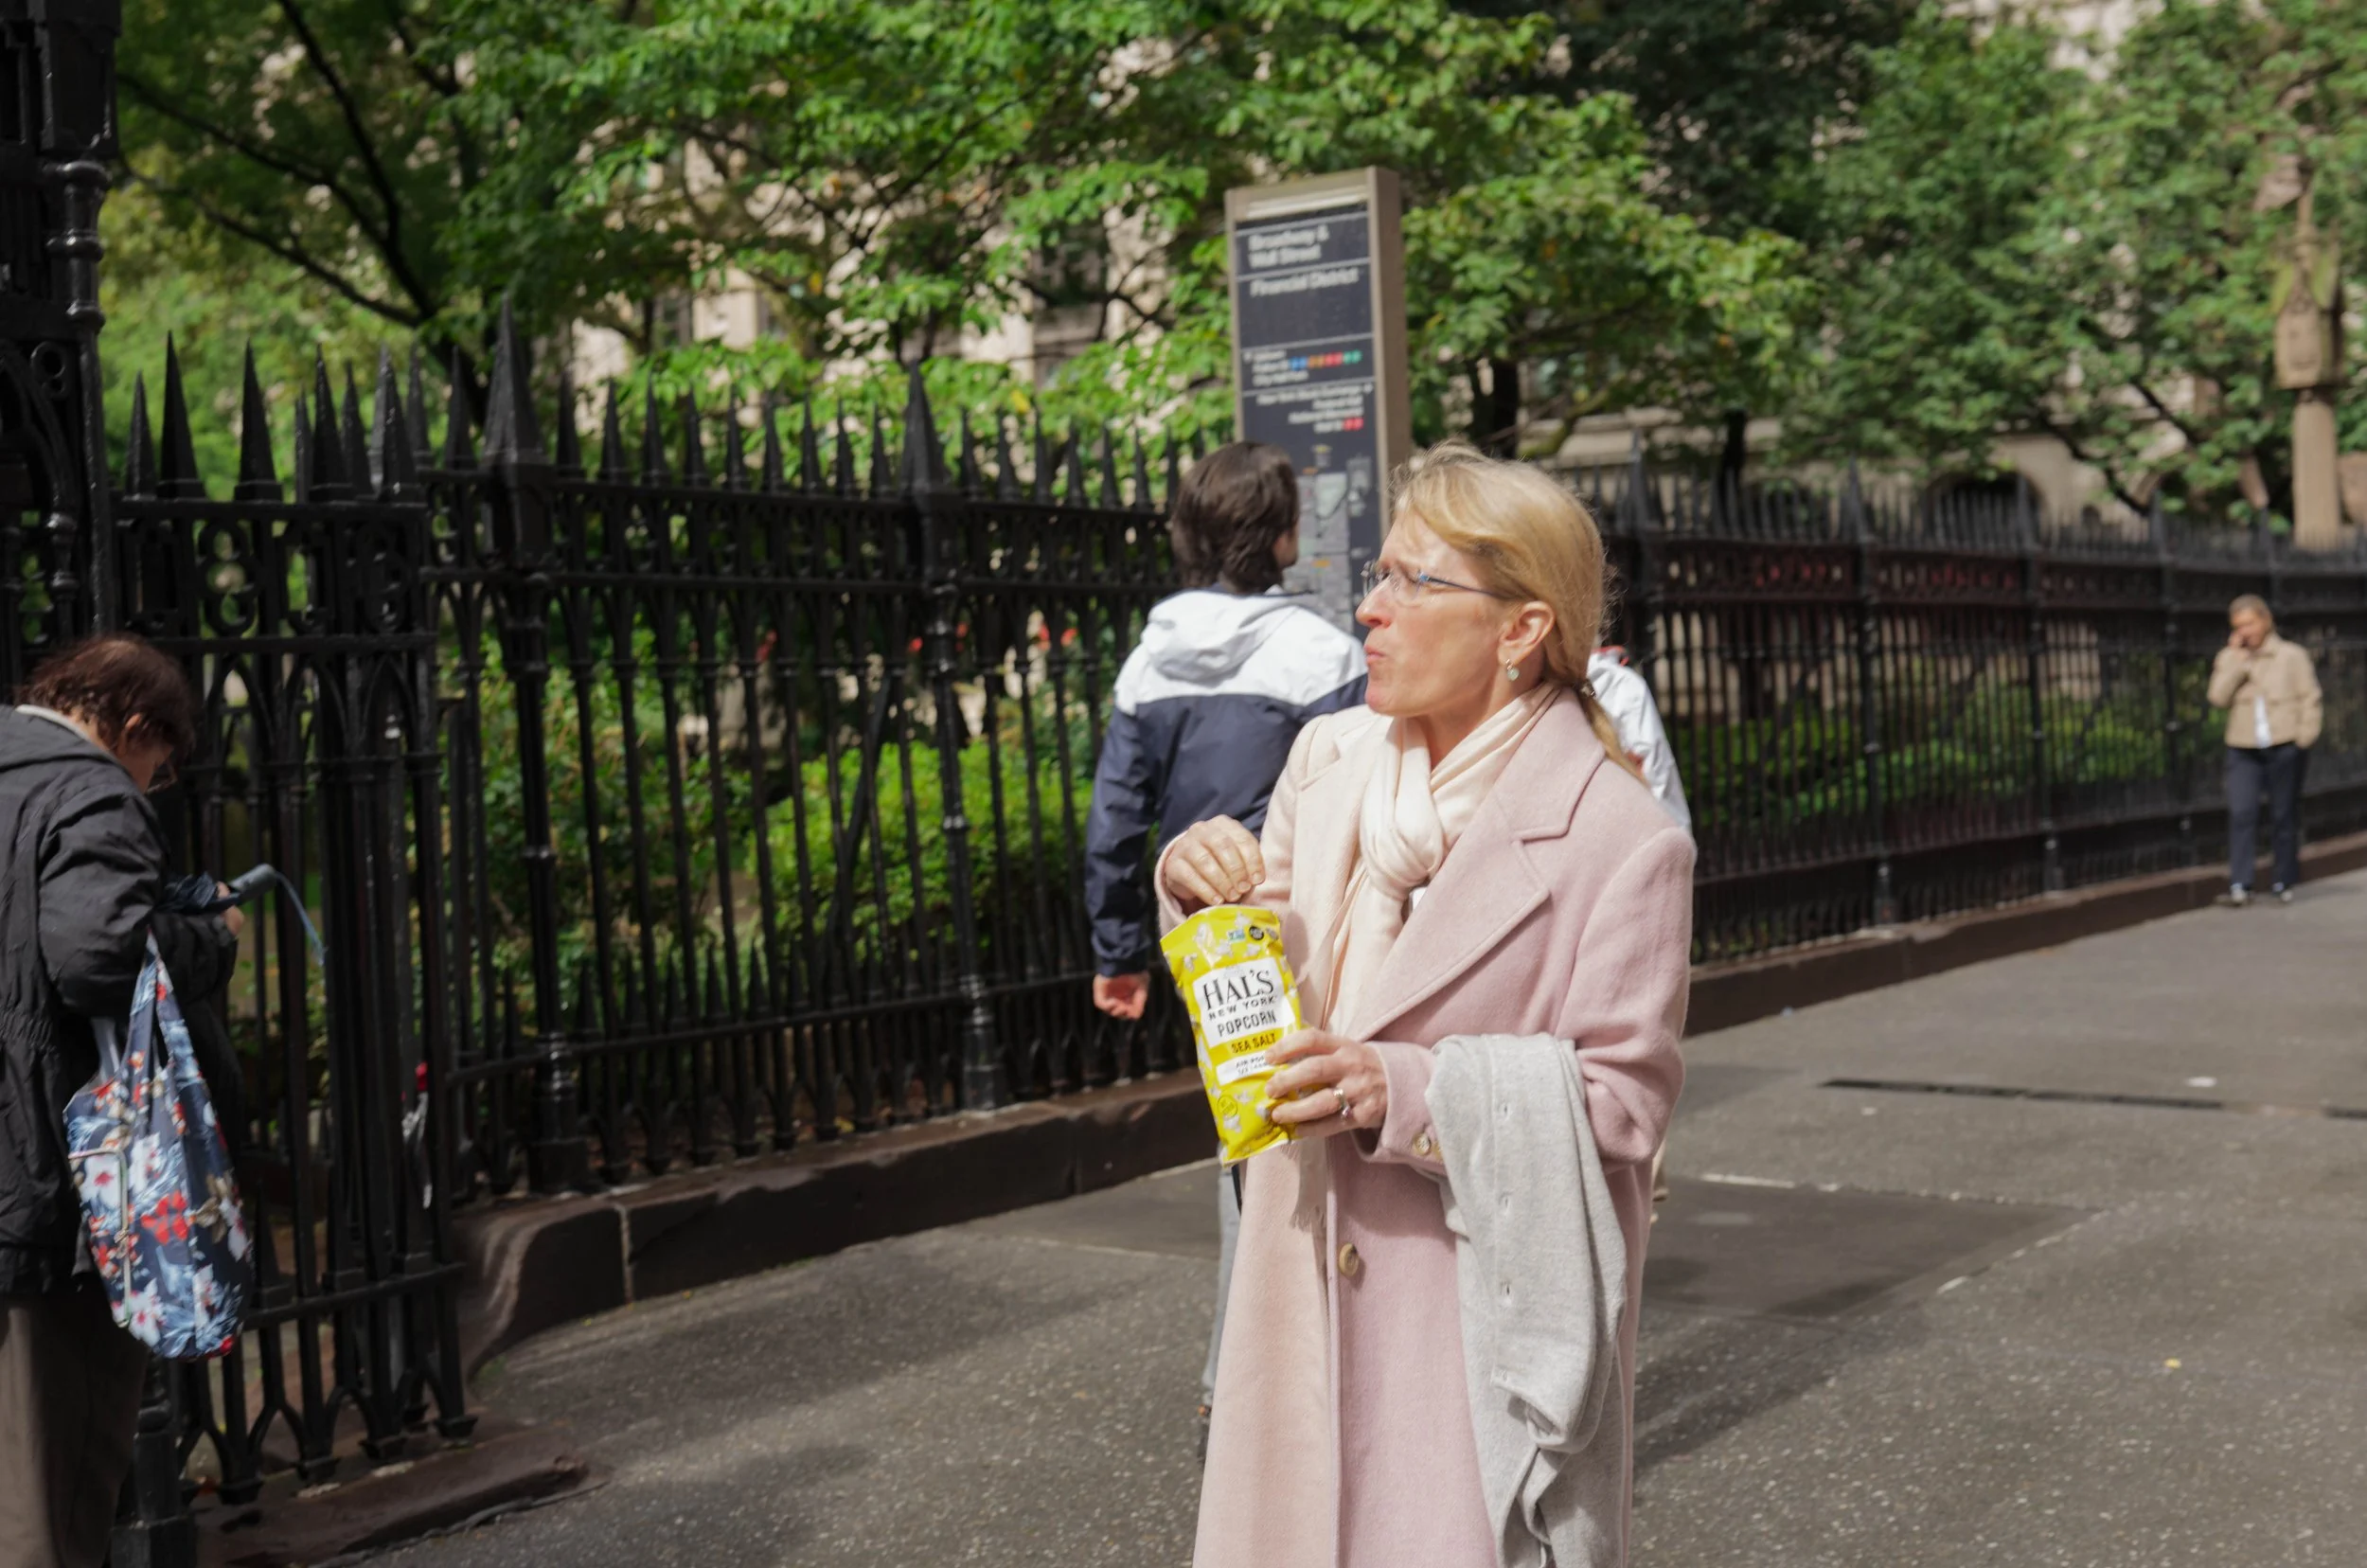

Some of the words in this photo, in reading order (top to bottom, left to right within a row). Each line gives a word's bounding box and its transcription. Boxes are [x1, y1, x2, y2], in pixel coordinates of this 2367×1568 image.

[1202, 969, 1273, 1010] HAL'S
[1208, 1001, 1237, 1021] NEW
[1218, 1009, 1276, 1037] POPCORN
[1231, 1041, 1252, 1054] SEA
[1254, 1033, 1276, 1049] SALT
